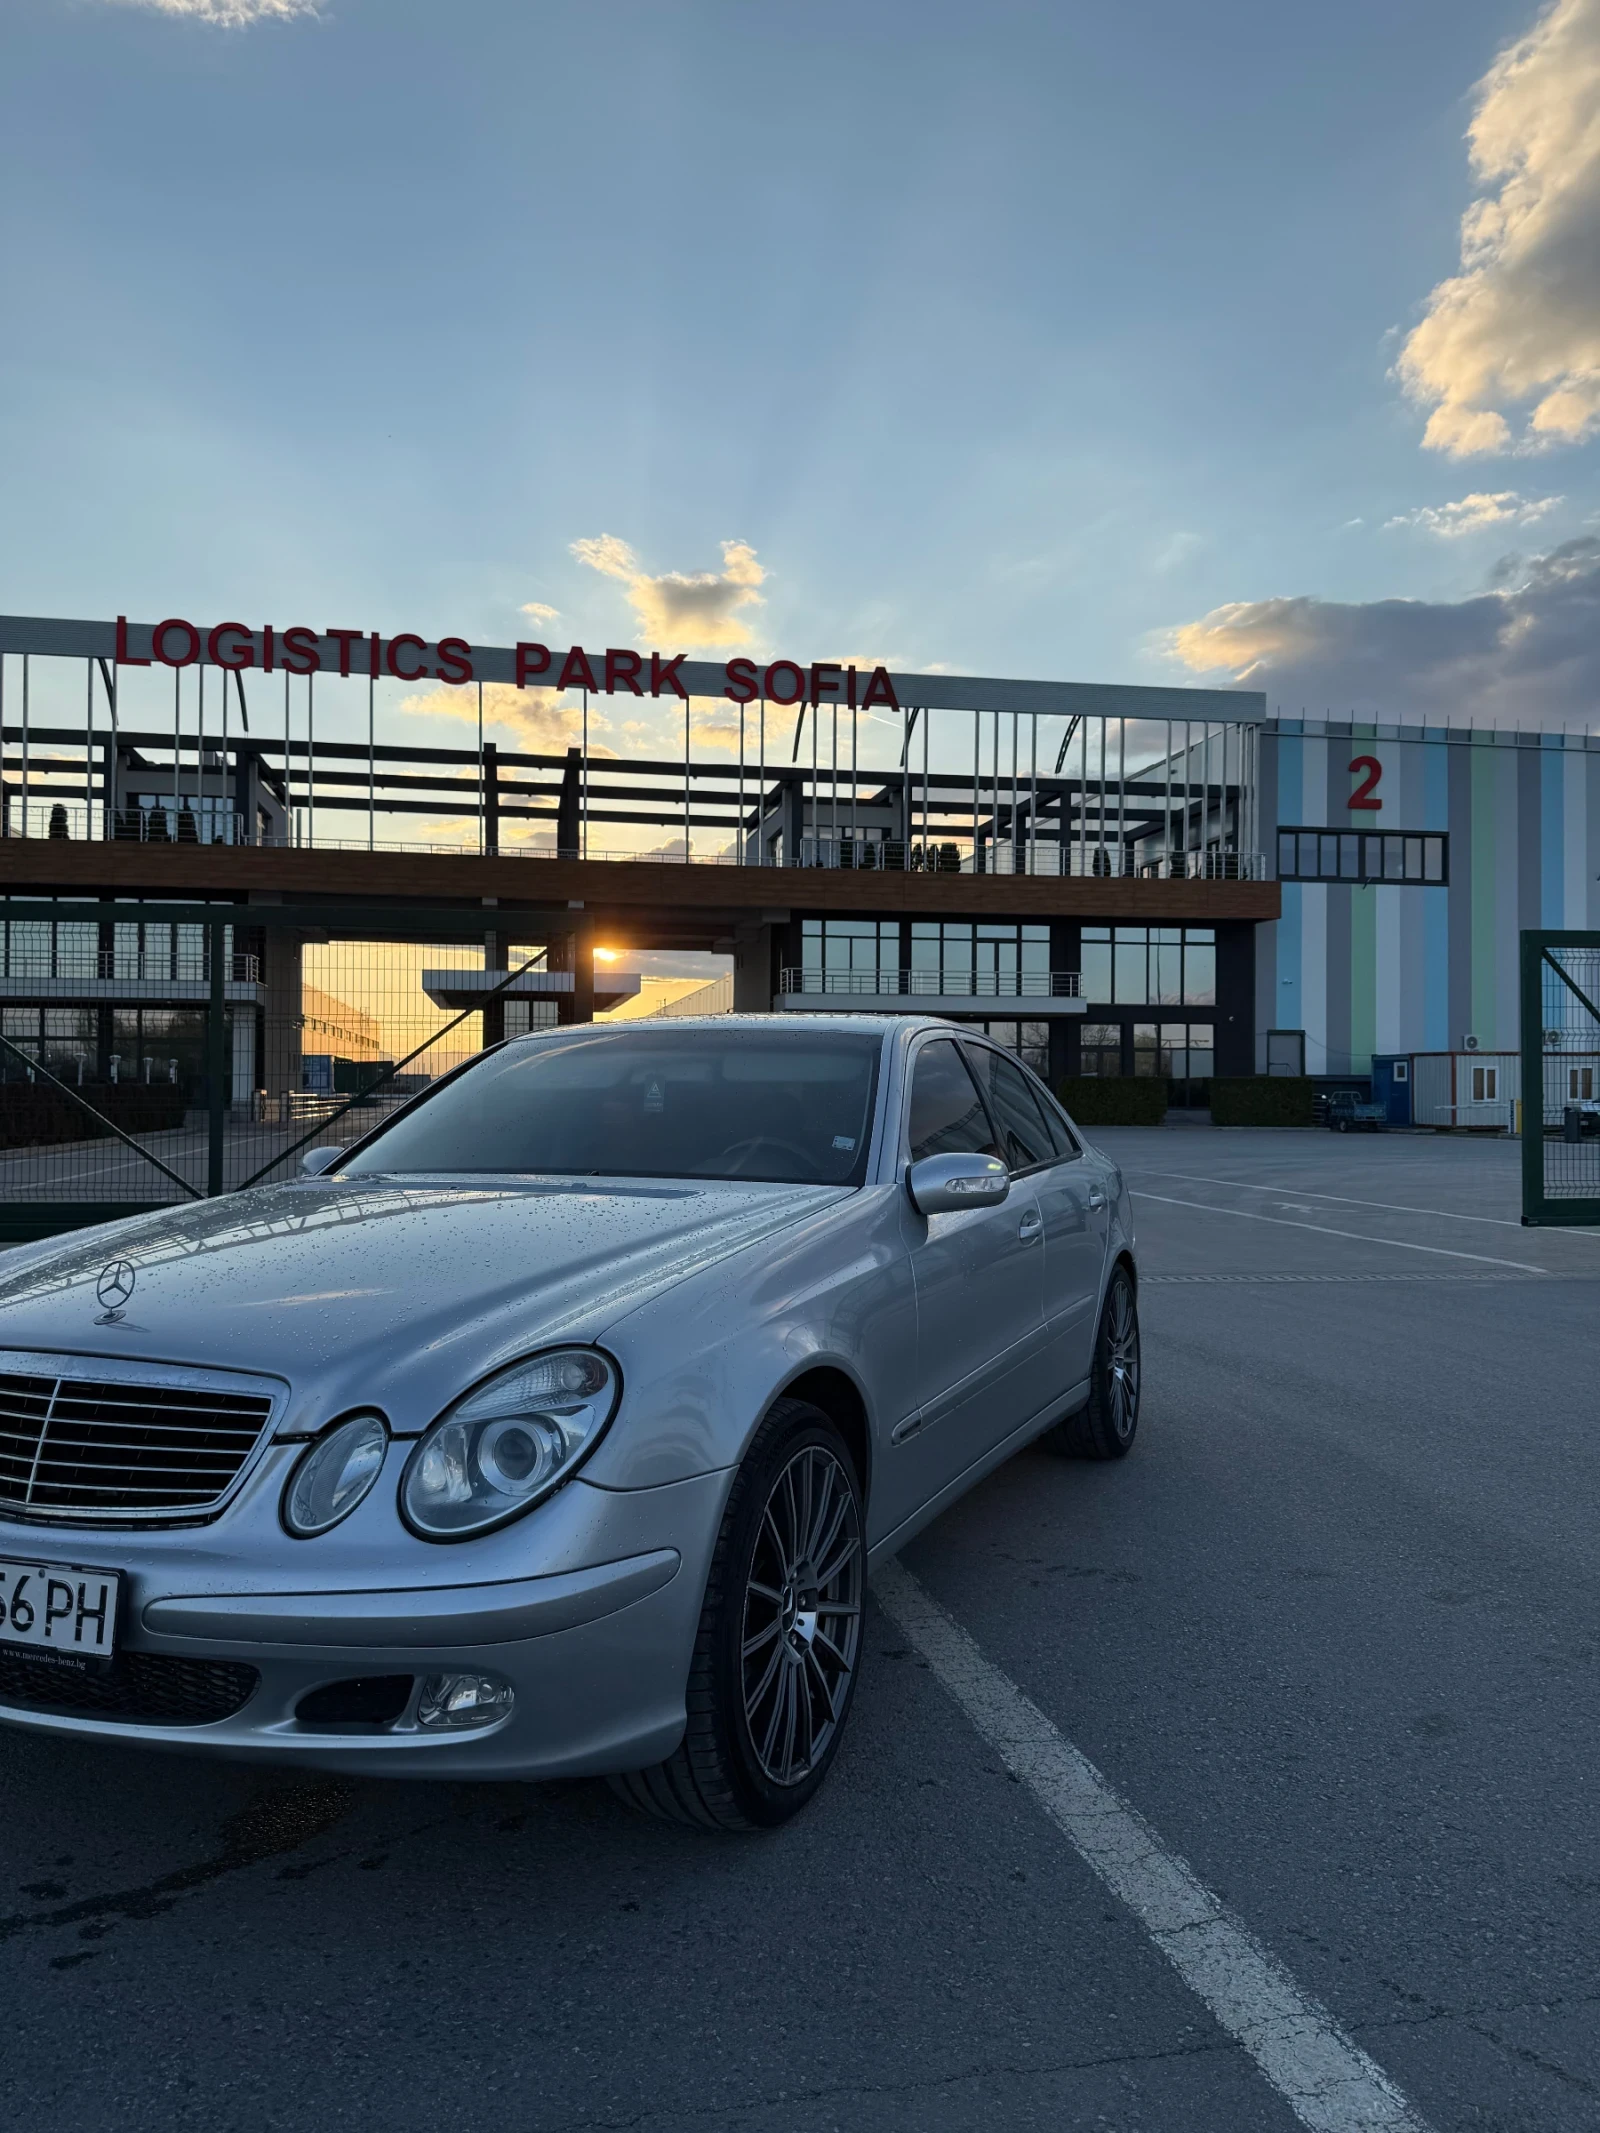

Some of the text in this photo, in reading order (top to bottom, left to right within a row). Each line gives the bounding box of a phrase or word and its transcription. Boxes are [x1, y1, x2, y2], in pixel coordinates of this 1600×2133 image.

[116, 616, 900, 712] LOGISTICS PARK SOFIA
[1347, 755, 1383, 810] 2
[2, 1648, 86, 1671] www.mercedes-benz.bg
